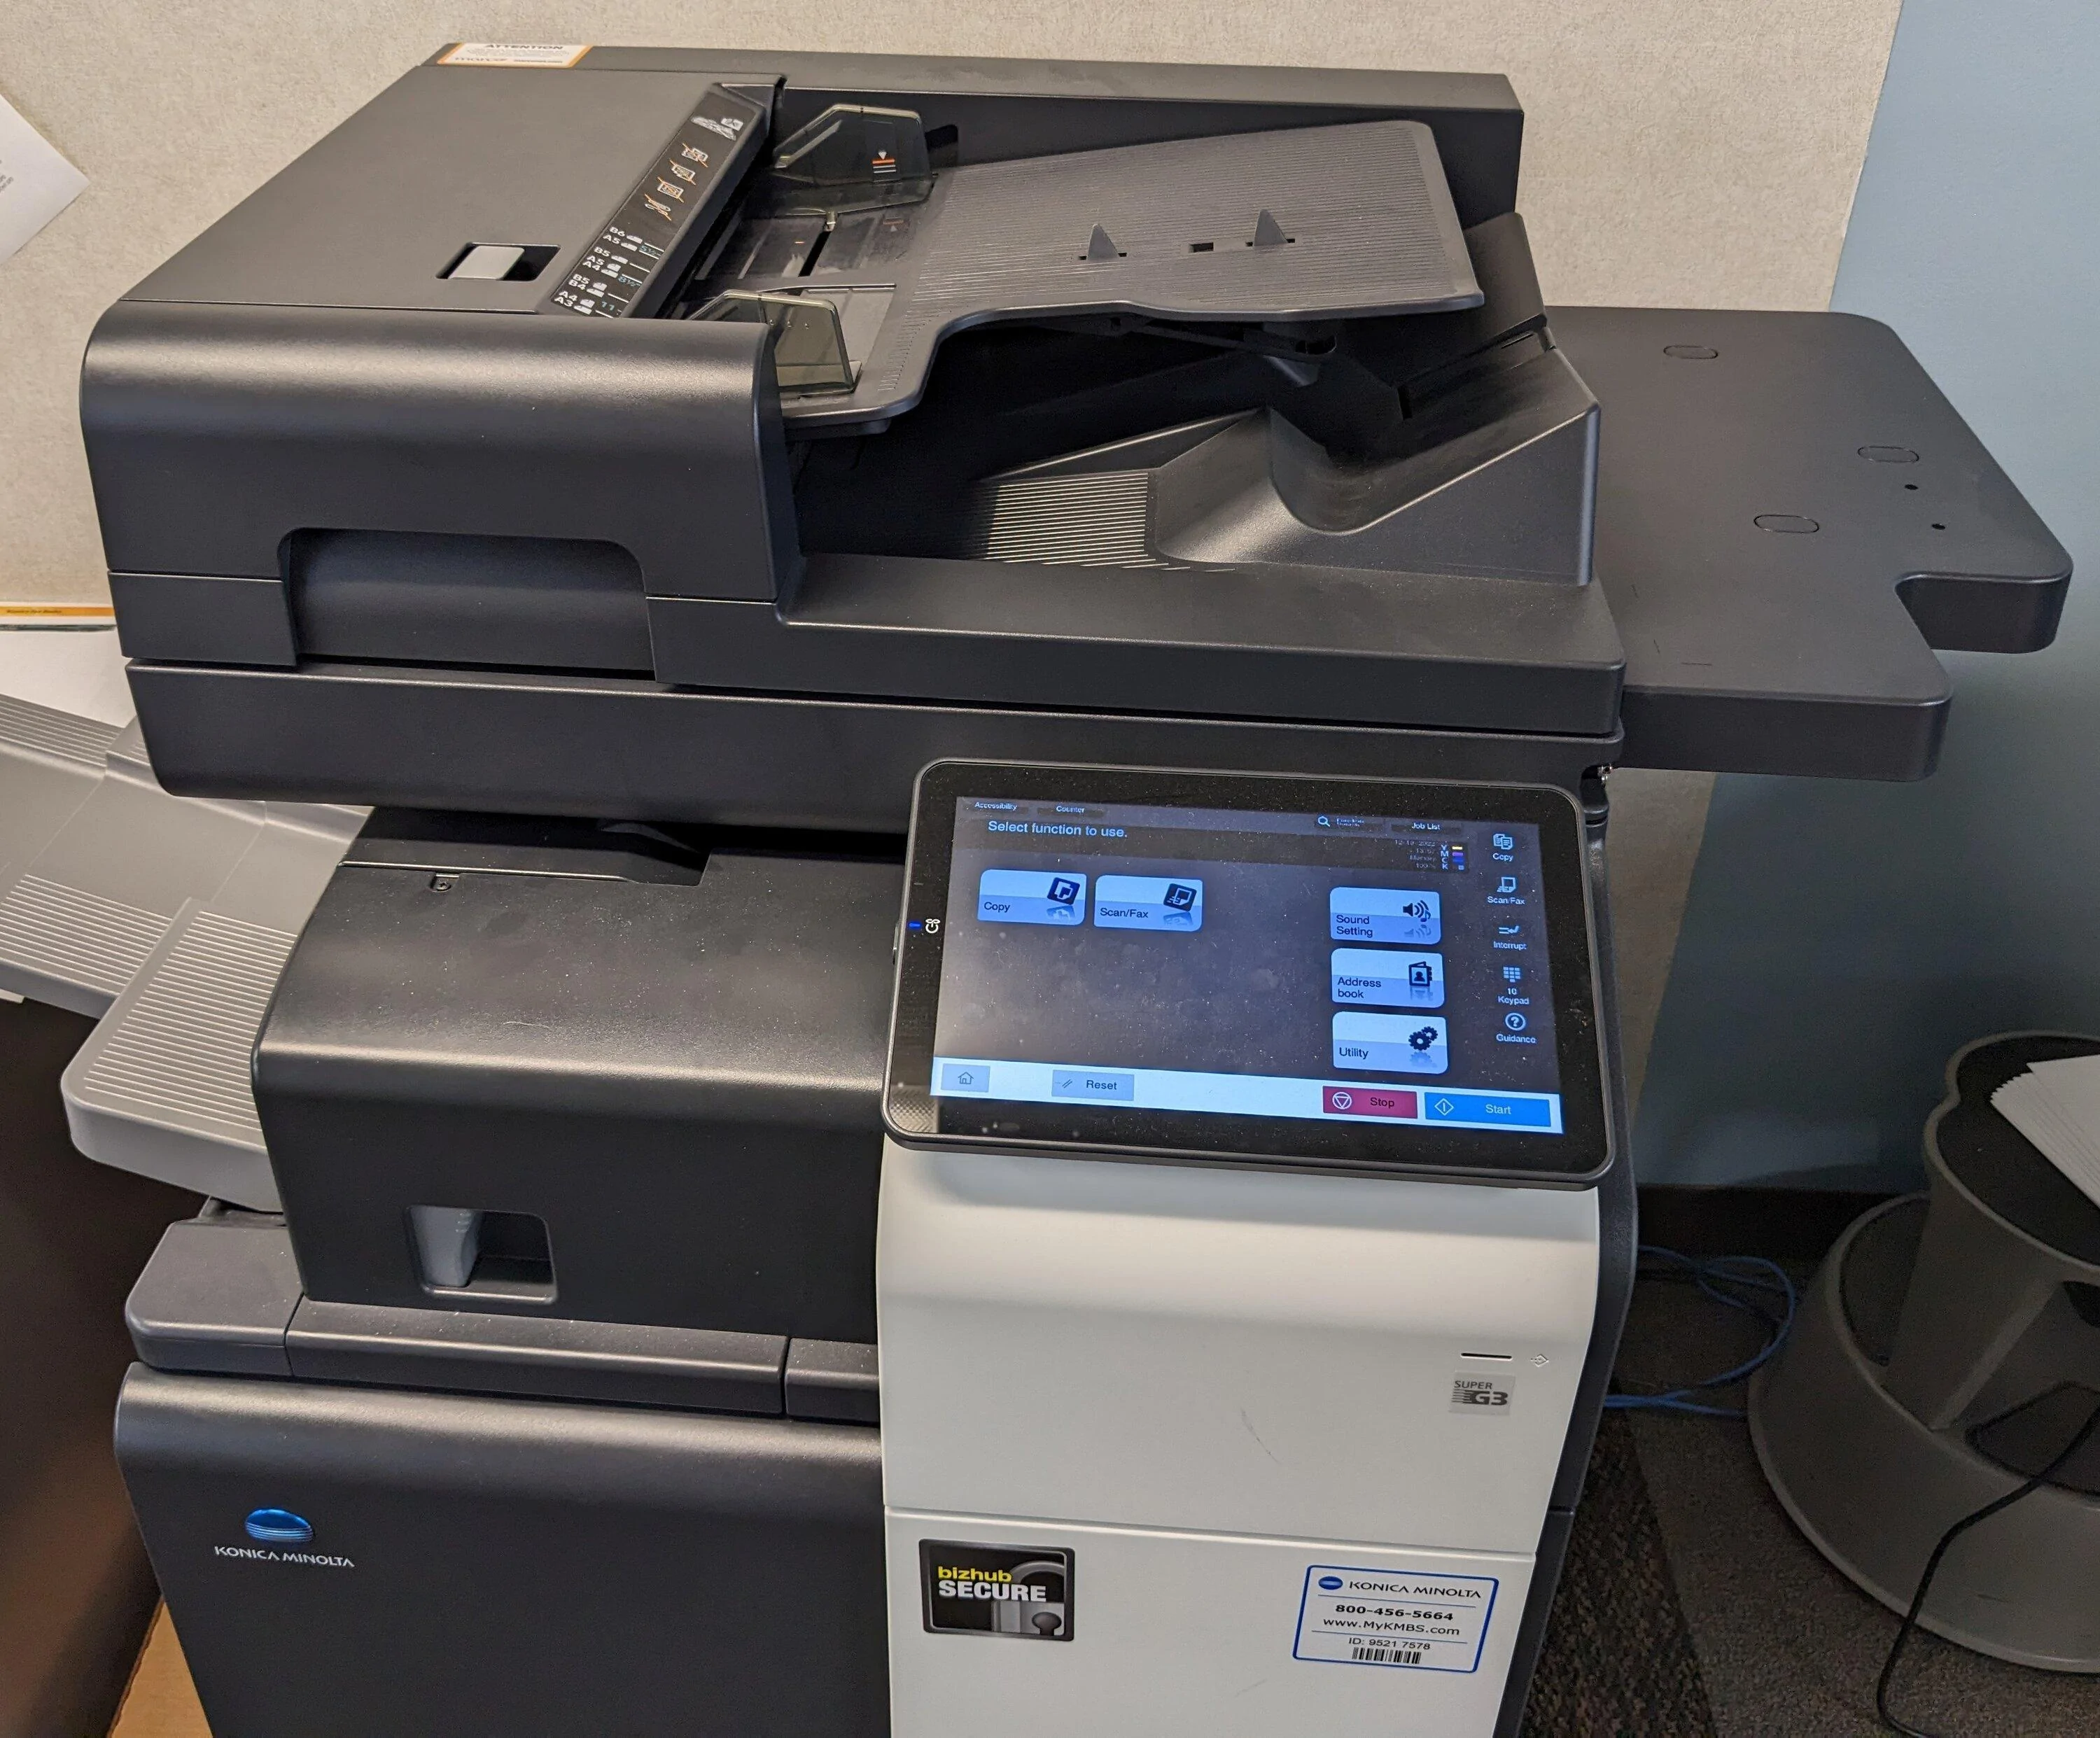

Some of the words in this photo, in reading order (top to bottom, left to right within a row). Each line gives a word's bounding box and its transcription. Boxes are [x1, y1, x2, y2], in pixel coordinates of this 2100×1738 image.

[609, 227, 626, 237] B6
[603, 234, 621, 244] A5
[594, 246, 611, 257] B5
[587, 255, 605, 265] A5
[582, 261, 601, 271] A4
[568, 279, 586, 290] B4
[573, 274, 590, 284] B5
[559, 290, 578, 301] A4
[554, 296, 573, 307] A3
[974, 801, 1017, 811] Accessibility
[1056, 805, 1085, 813] Counter
[988, 820, 1028, 833] Select
[1032, 822, 1082, 835] function
[1085, 825, 1097, 836] to
[1100, 827, 1128, 838] use.
[1411, 822, 1425, 830] Job
[1427, 822, 1441, 831] List
[1492, 853, 1514, 862] Copy
[983, 901, 1011, 913] Copy
[1100, 906, 1149, 918] Scan/Fax
[1336, 914, 1371, 925] Sound
[1336, 926, 1373, 938] Setting
[1493, 941, 1527, 951] Interrupt
[1338, 977, 1382, 988] Address
[1338, 988, 1364, 999] book
[1498, 995, 1530, 1006] Keypad
[1496, 1033, 1537, 1044] Guidance
[1338, 1047, 1369, 1060] Utility
[1086, 1079, 1118, 1091] Reset
[1370, 1096, 1395, 1109] Stop
[1485, 1104, 1512, 1115] Start
[1454, 1380, 1492, 1389] SUPER
[1473, 1389, 1508, 1406] G3
[214, 1546, 279, 1561] KONICA
[282, 1553, 355, 1568] MINOLTA
[937, 1566, 1013, 1582] bizhub
[938, 1580, 1047, 1602] SECURE
[1349, 1581, 1409, 1593] KONICA
[1413, 1585, 1482, 1599] MINOLTA
[1335, 1604, 1454, 1621] 800-456-5664
[1322, 1618, 1460, 1635] www.MyKMBS.com
[1348, 1637, 1365, 1646] ID:
[1368, 1639, 1396, 1648] 9521
[1402, 1641, 1431, 1651] 7578
